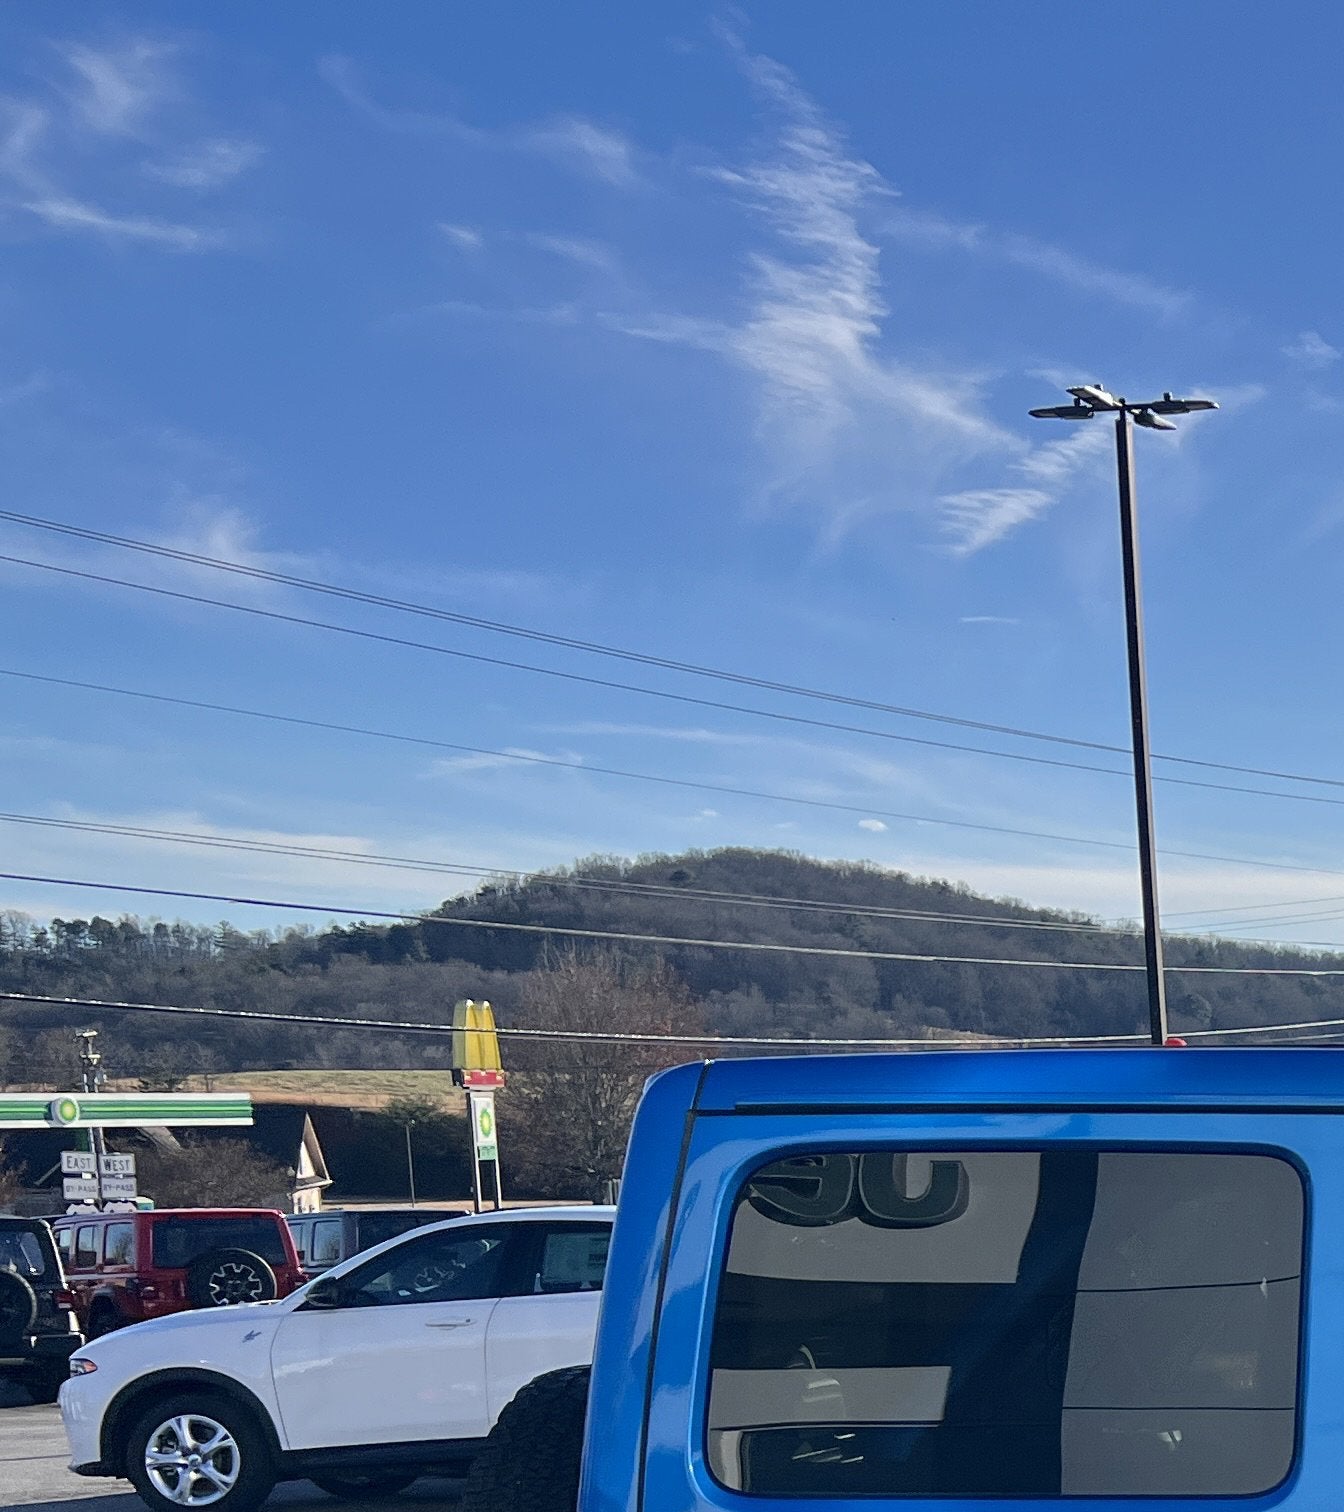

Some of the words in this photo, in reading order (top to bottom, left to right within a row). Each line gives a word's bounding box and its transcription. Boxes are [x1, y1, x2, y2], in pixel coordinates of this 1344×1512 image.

[66, 1155, 92, 1169] EAST
[103, 1158, 131, 1172] WEST
[65, 1185, 97, 1193] BY-PASS
[102, 1184, 135, 1192] BY-PASS
